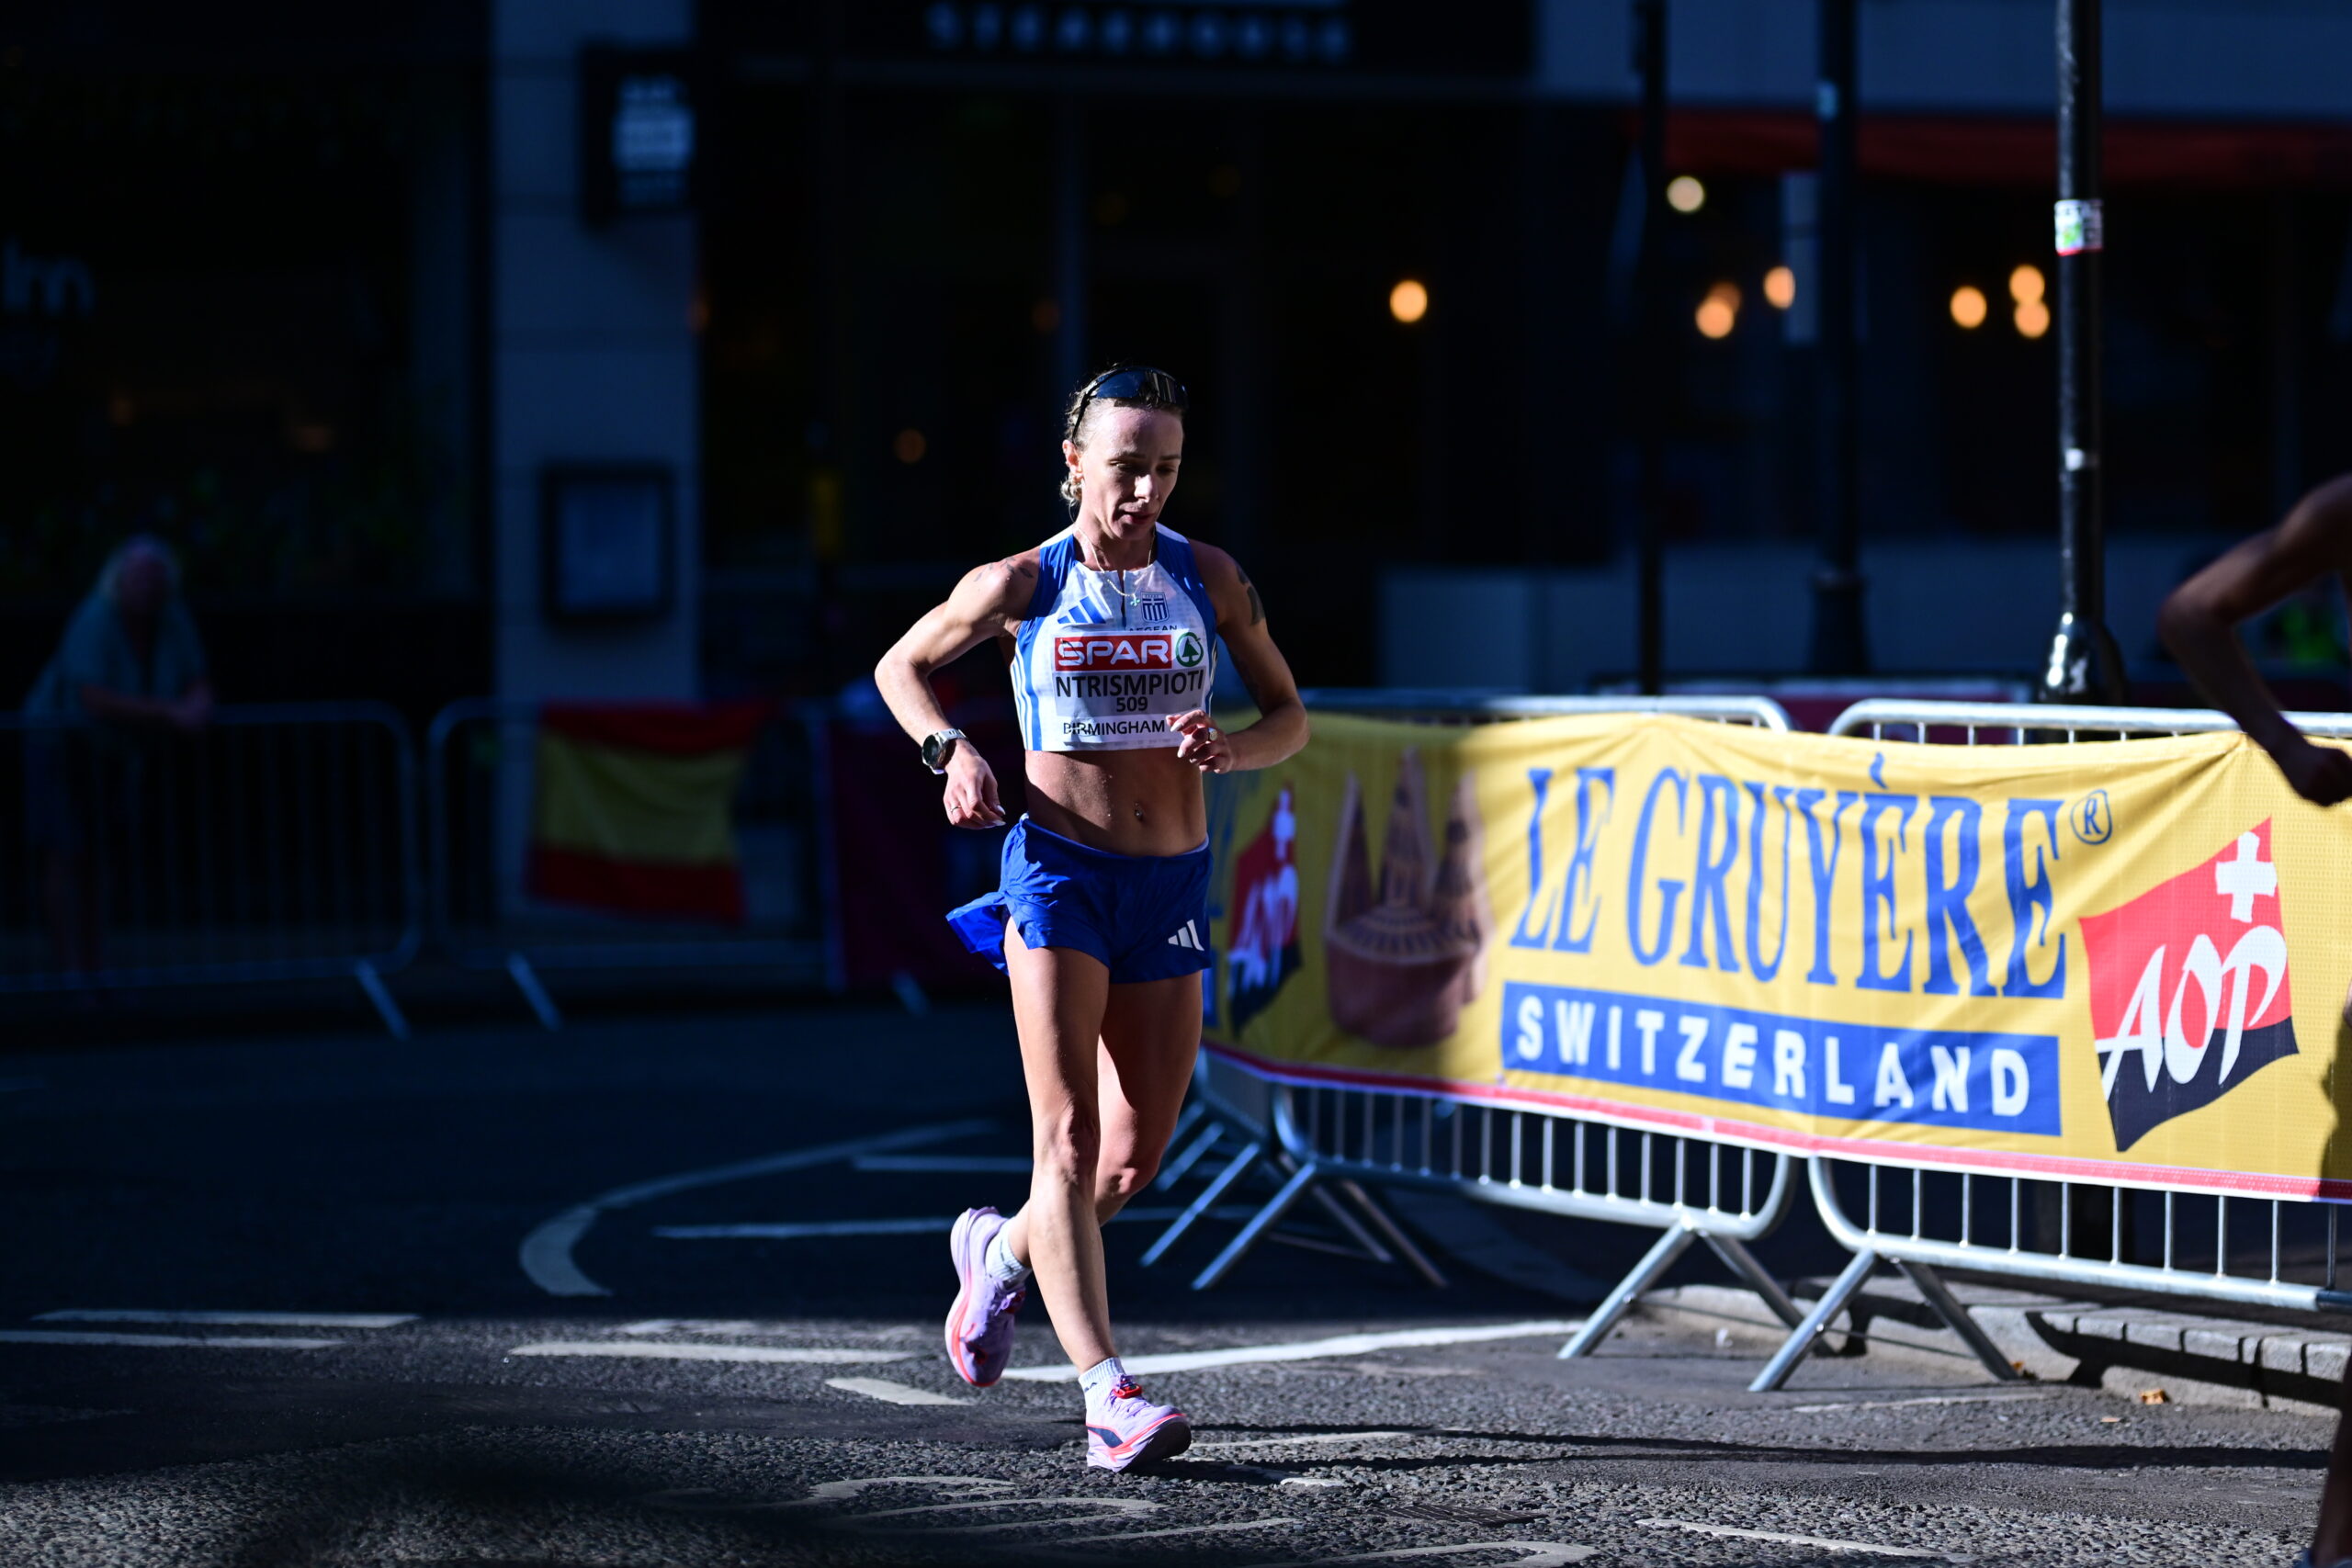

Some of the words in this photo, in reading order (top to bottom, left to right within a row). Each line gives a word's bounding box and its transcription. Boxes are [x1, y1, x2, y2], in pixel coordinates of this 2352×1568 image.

[1057, 639, 1170, 667] SPAR
[1056, 670, 1204, 698] NTRISMPIOTI
[1115, 696, 1148, 713] 509
[1062, 719, 1166, 737] BIRMINGHAM
[1509, 766, 1616, 954] LE
[1625, 751, 2066, 1000] GRUYÈRE
[2095, 924, 2288, 1103] AOP
[1516, 994, 2031, 1117] SWITZERLAND
